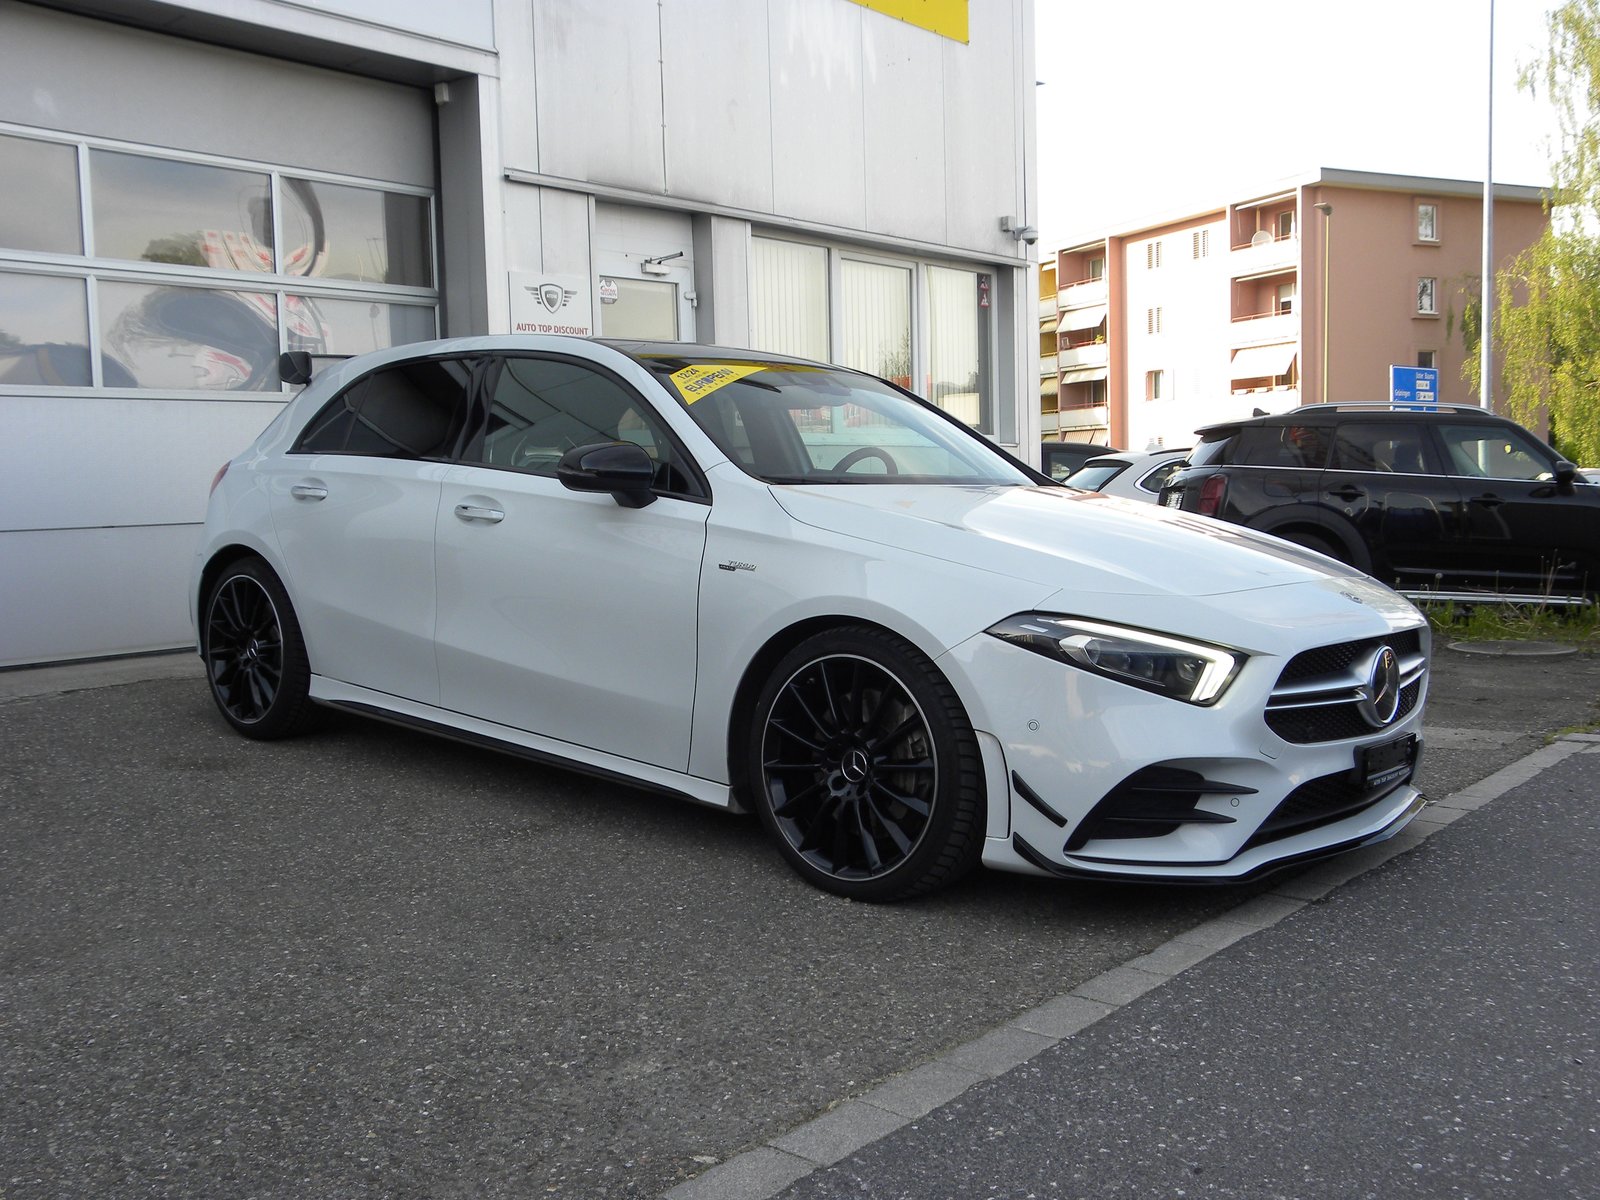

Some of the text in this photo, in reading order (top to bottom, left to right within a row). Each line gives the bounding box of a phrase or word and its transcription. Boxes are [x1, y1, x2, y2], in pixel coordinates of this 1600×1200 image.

[516, 323, 588, 336] AUTO TOP DISCOUNT
